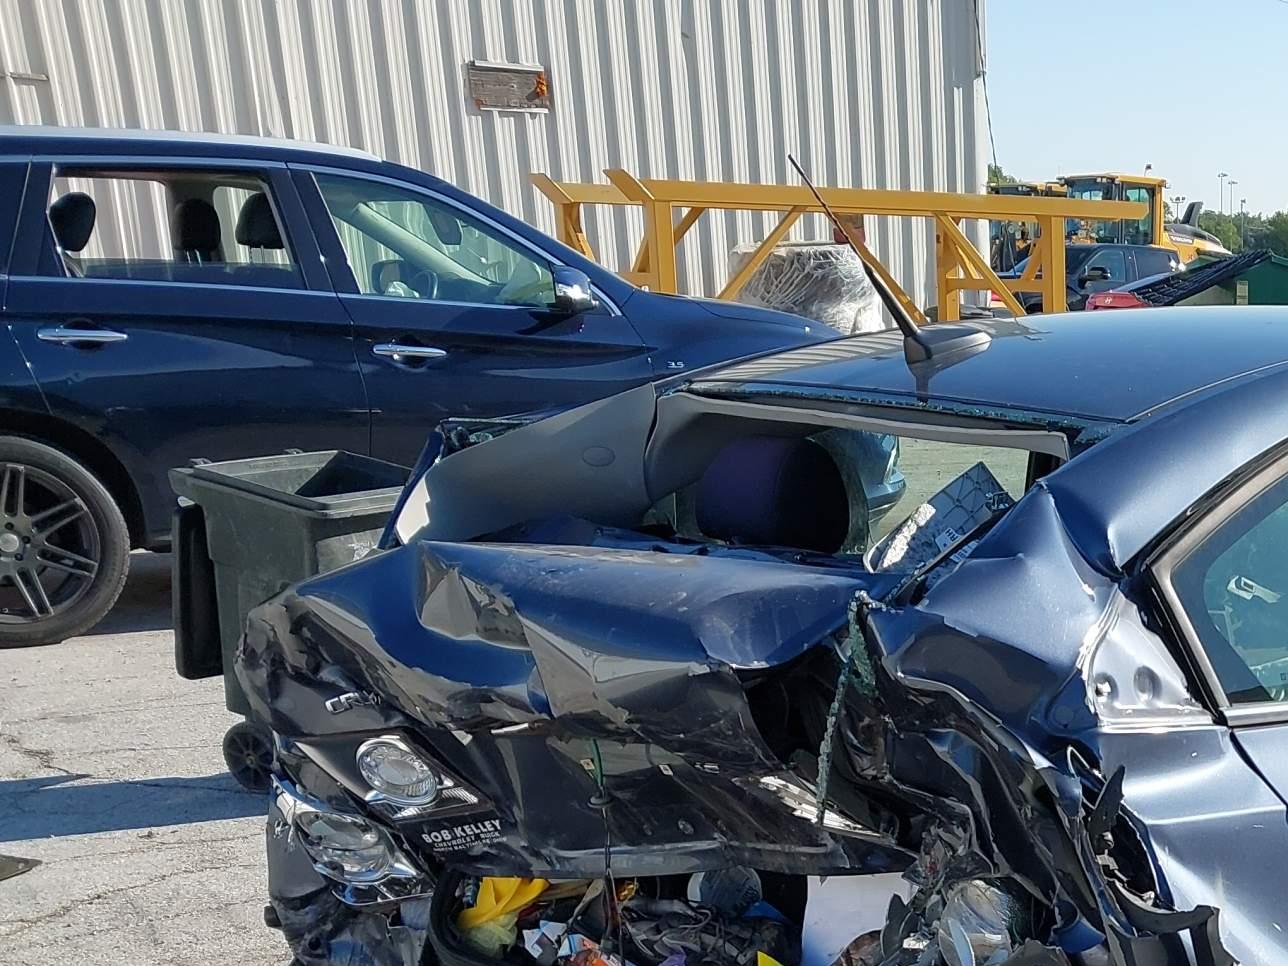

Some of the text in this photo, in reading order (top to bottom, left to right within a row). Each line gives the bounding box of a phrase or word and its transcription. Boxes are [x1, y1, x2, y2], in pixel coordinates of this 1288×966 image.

[421, 819, 502, 844] BOB KELLEY
[434, 835, 475, 849] CHEVROLET
